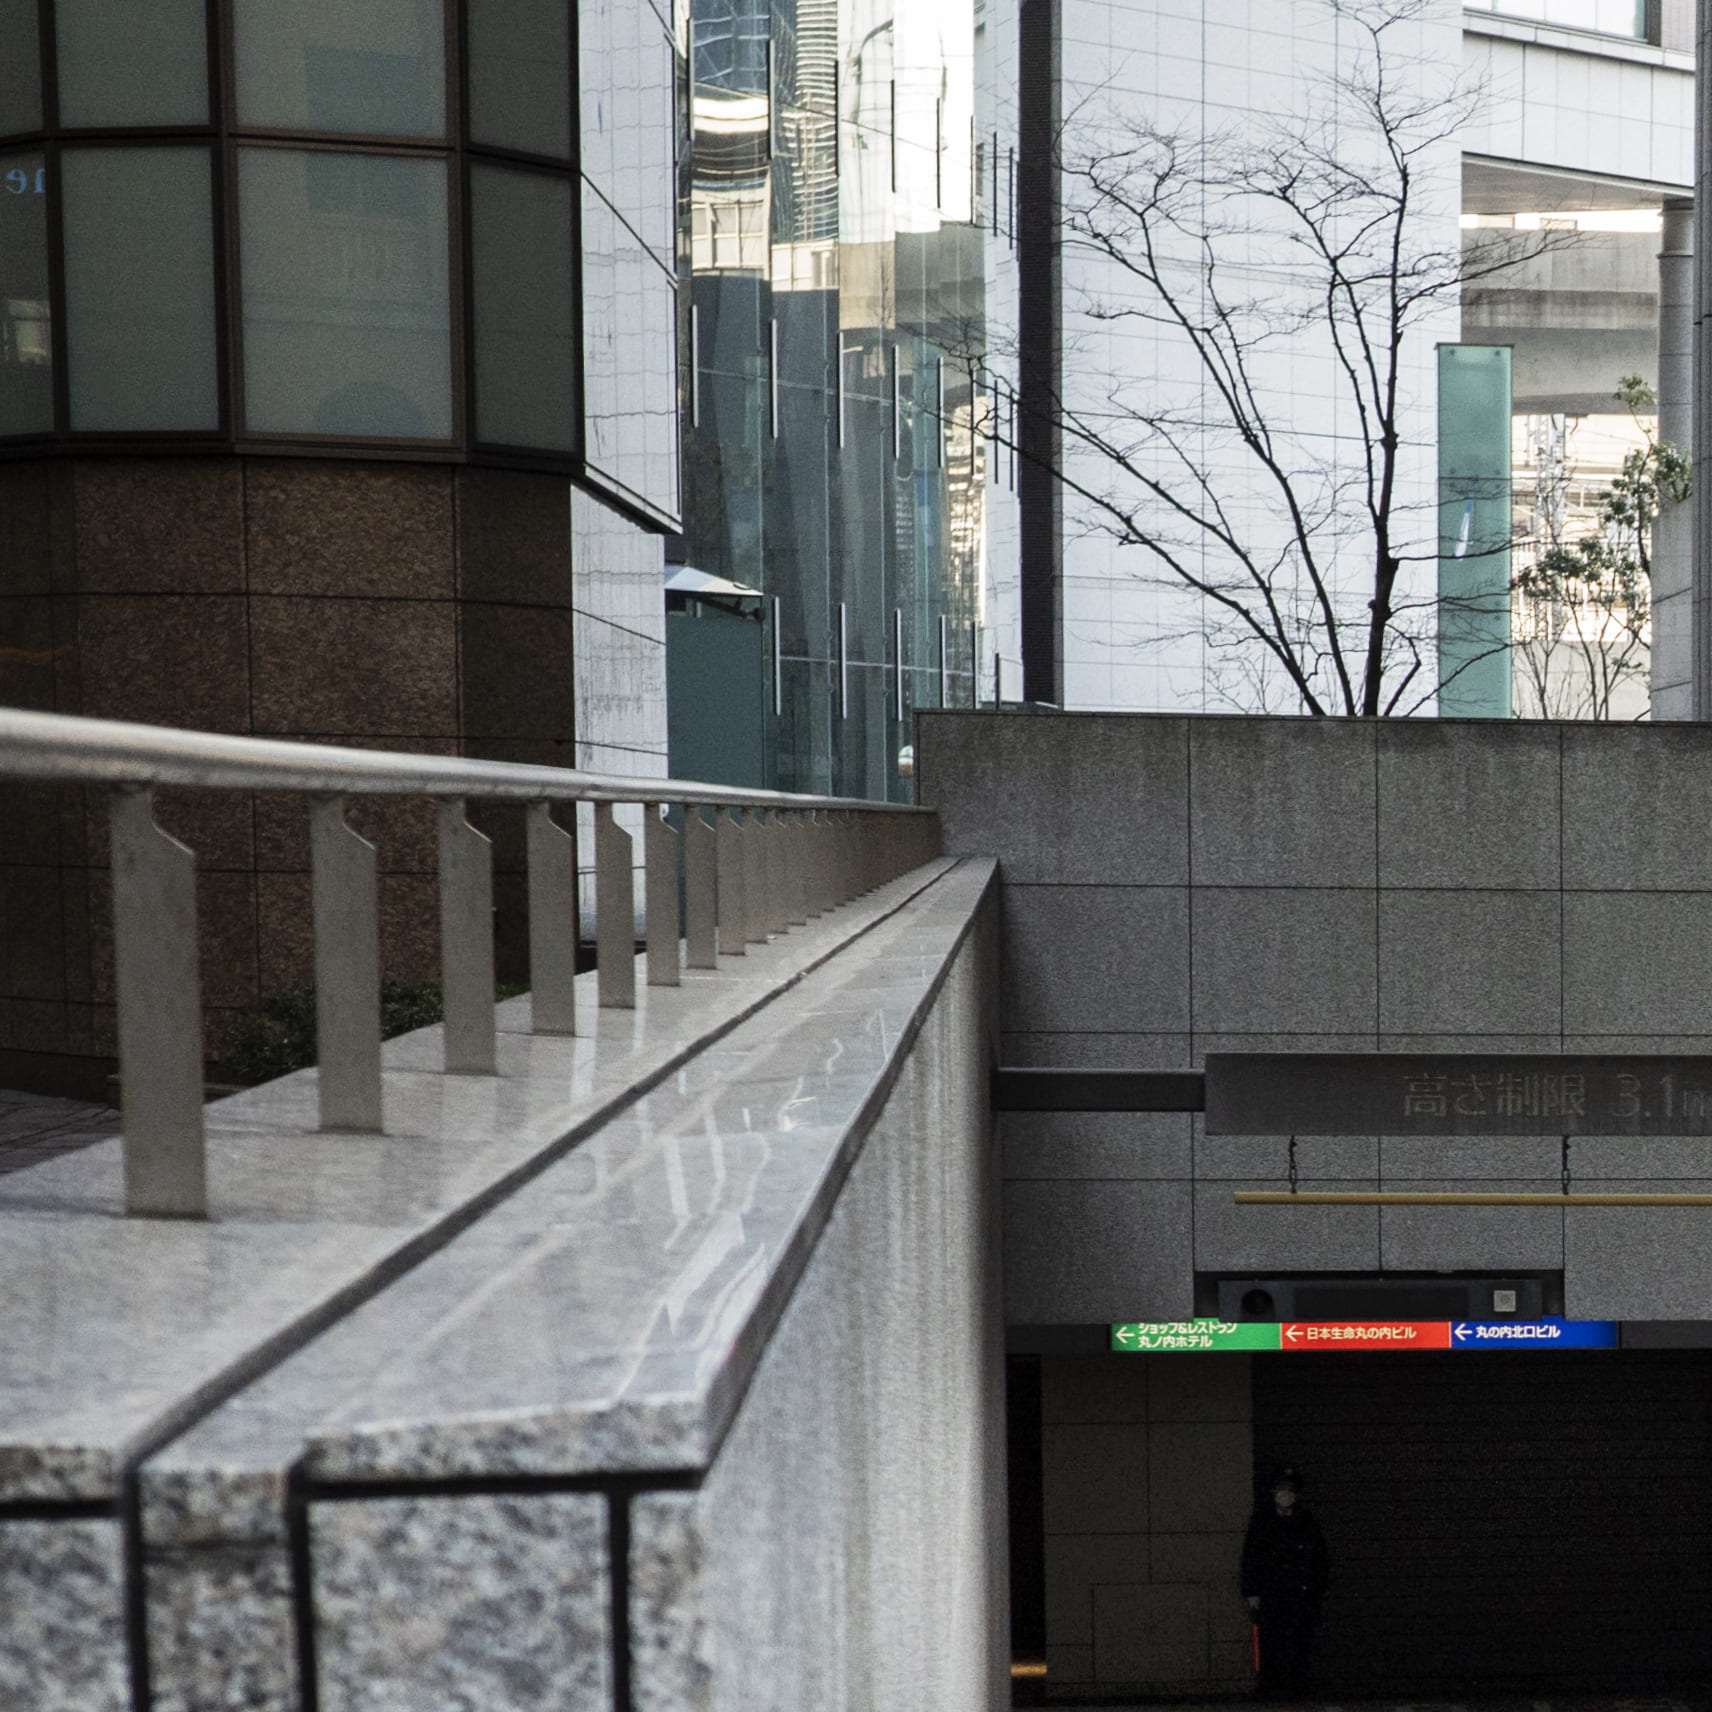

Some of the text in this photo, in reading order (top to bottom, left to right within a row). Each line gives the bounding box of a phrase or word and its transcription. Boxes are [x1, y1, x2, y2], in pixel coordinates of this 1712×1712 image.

[1403, 1072, 1586, 1118] 高さ制限
[1306, 1325, 1417, 1340] 日本生命丸の内ビル
[1475, 1324, 1562, 1339] 丸の内北口ビル
[1138, 1335, 1214, 1348] 丸ノ内ホテル
